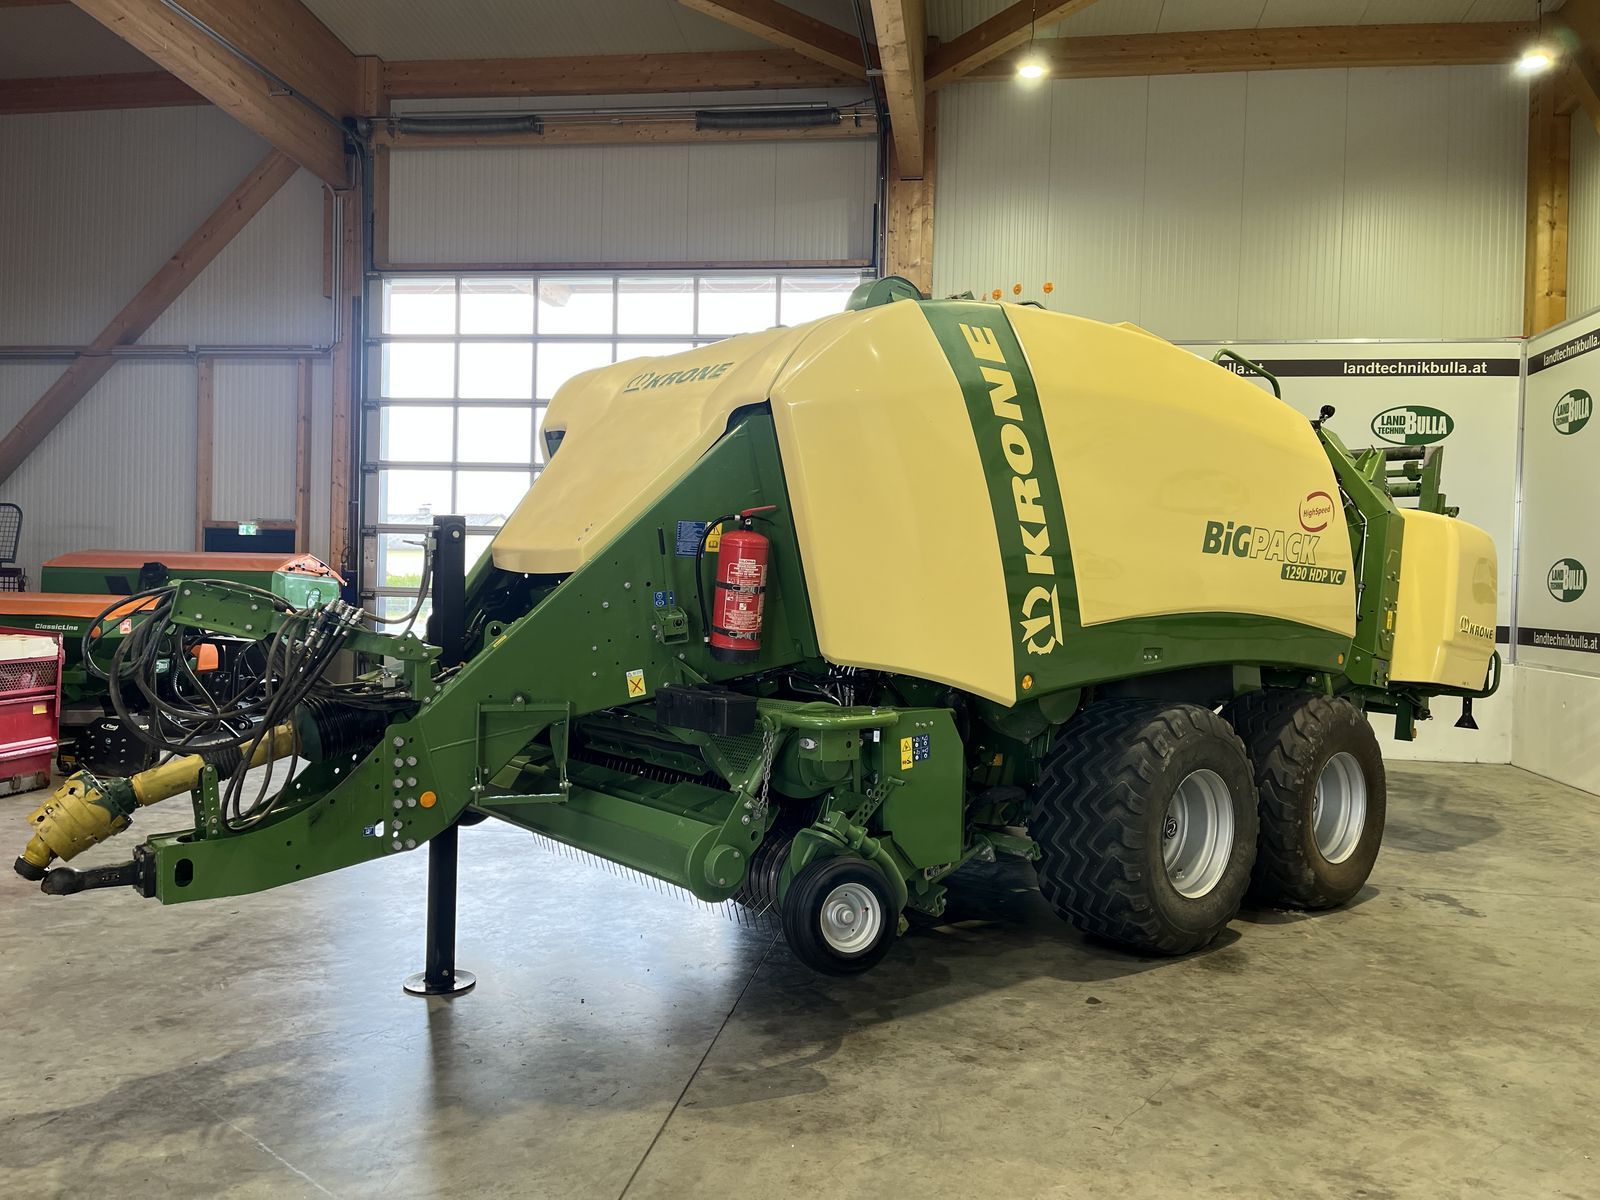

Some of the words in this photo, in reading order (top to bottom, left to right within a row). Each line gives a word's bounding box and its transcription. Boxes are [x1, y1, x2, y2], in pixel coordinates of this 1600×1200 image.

[642, 362, 735, 389] KRONE
[1343, 361, 1487, 374] landtechnikbulla.at
[1568, 397, 1590, 422] BULLA
[1381, 415, 1406, 426] LAND
[1405, 411, 1447, 435] BULLA
[1378, 427, 1406, 435] TECHNIK
[958, 322, 1055, 575] KRONE
[1303, 505, 1331, 518] HighSpeed
[1285, 565, 1308, 580] 1290
[1308, 568, 1328, 582] HDP
[1330, 570, 1342, 583] VC
[1563, 565, 1584, 590] BULLA
[35, 623, 78, 631] ClassicLine
[1470, 623, 1494, 639] KRONE
[1534, 631, 1598, 650] landtechnikbulla.at
